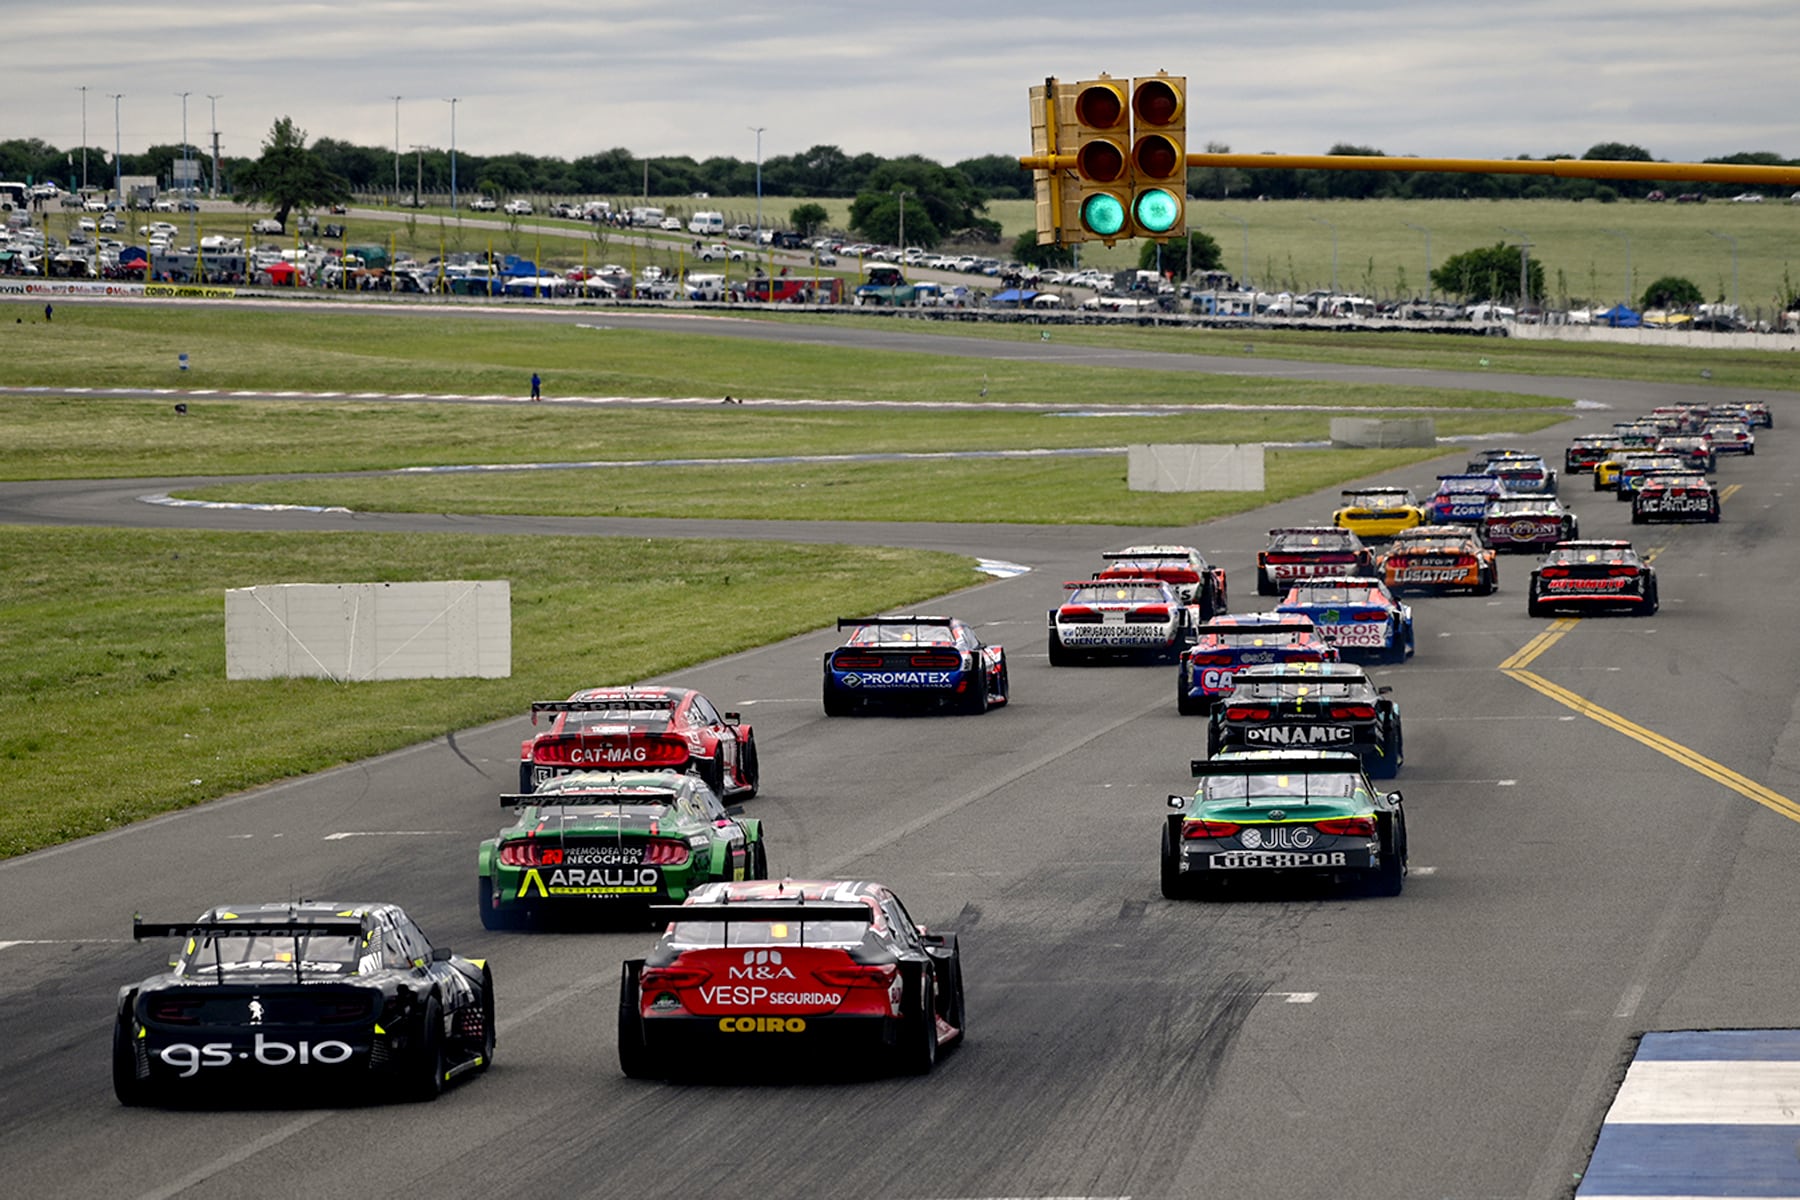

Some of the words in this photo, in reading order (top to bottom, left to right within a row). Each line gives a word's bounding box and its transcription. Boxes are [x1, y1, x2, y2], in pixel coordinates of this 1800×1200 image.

[1111, 638, 1168, 646] CEREALES
[863, 672, 951, 683] PROMATEX
[1248, 726, 1351, 744] DYNAMIC
[571, 747, 647, 762] CAT-MAG
[1262, 826, 1314, 848] JLG
[567, 855, 639, 864] NECOCHEA
[549, 869, 658, 886] ARAUJO
[729, 966, 797, 980] M&A
[699, 986, 769, 1005] VESP
[770, 992, 842, 1005] SEGURIDAD
[719, 1017, 806, 1032] COIRO
